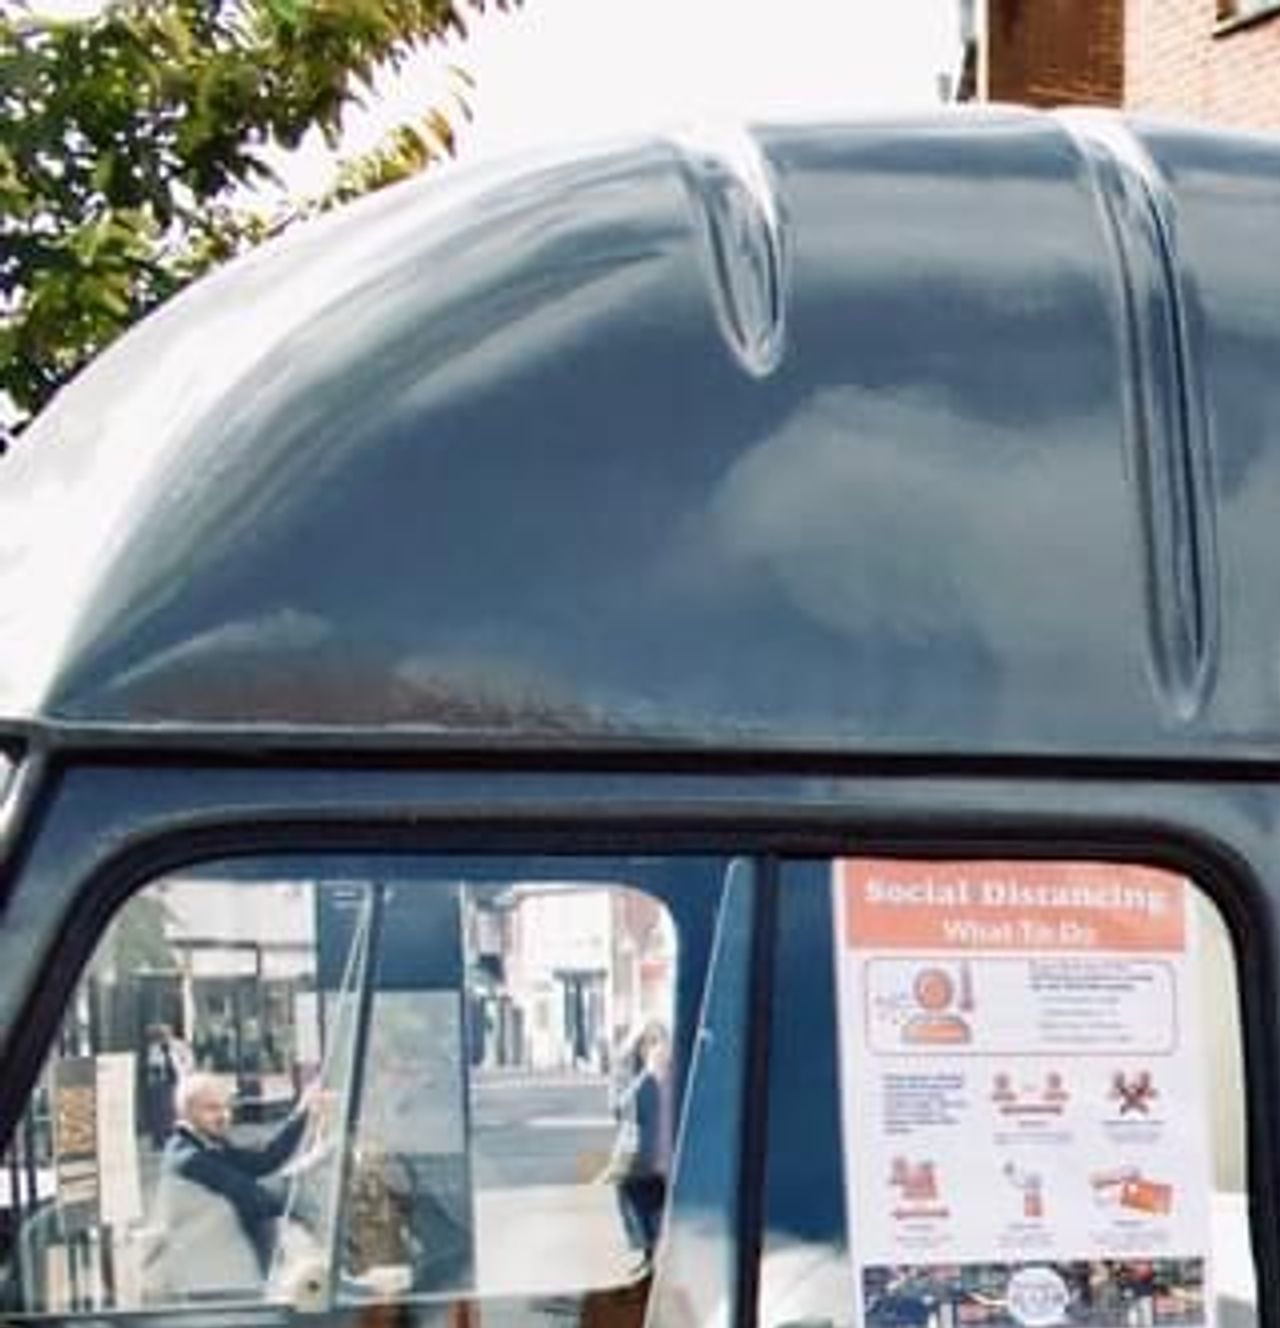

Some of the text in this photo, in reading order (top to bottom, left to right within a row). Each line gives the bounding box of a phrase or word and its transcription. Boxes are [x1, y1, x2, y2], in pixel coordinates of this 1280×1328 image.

[864, 876, 1168, 917] Social Distancing
[943, 919, 1013, 944] What
